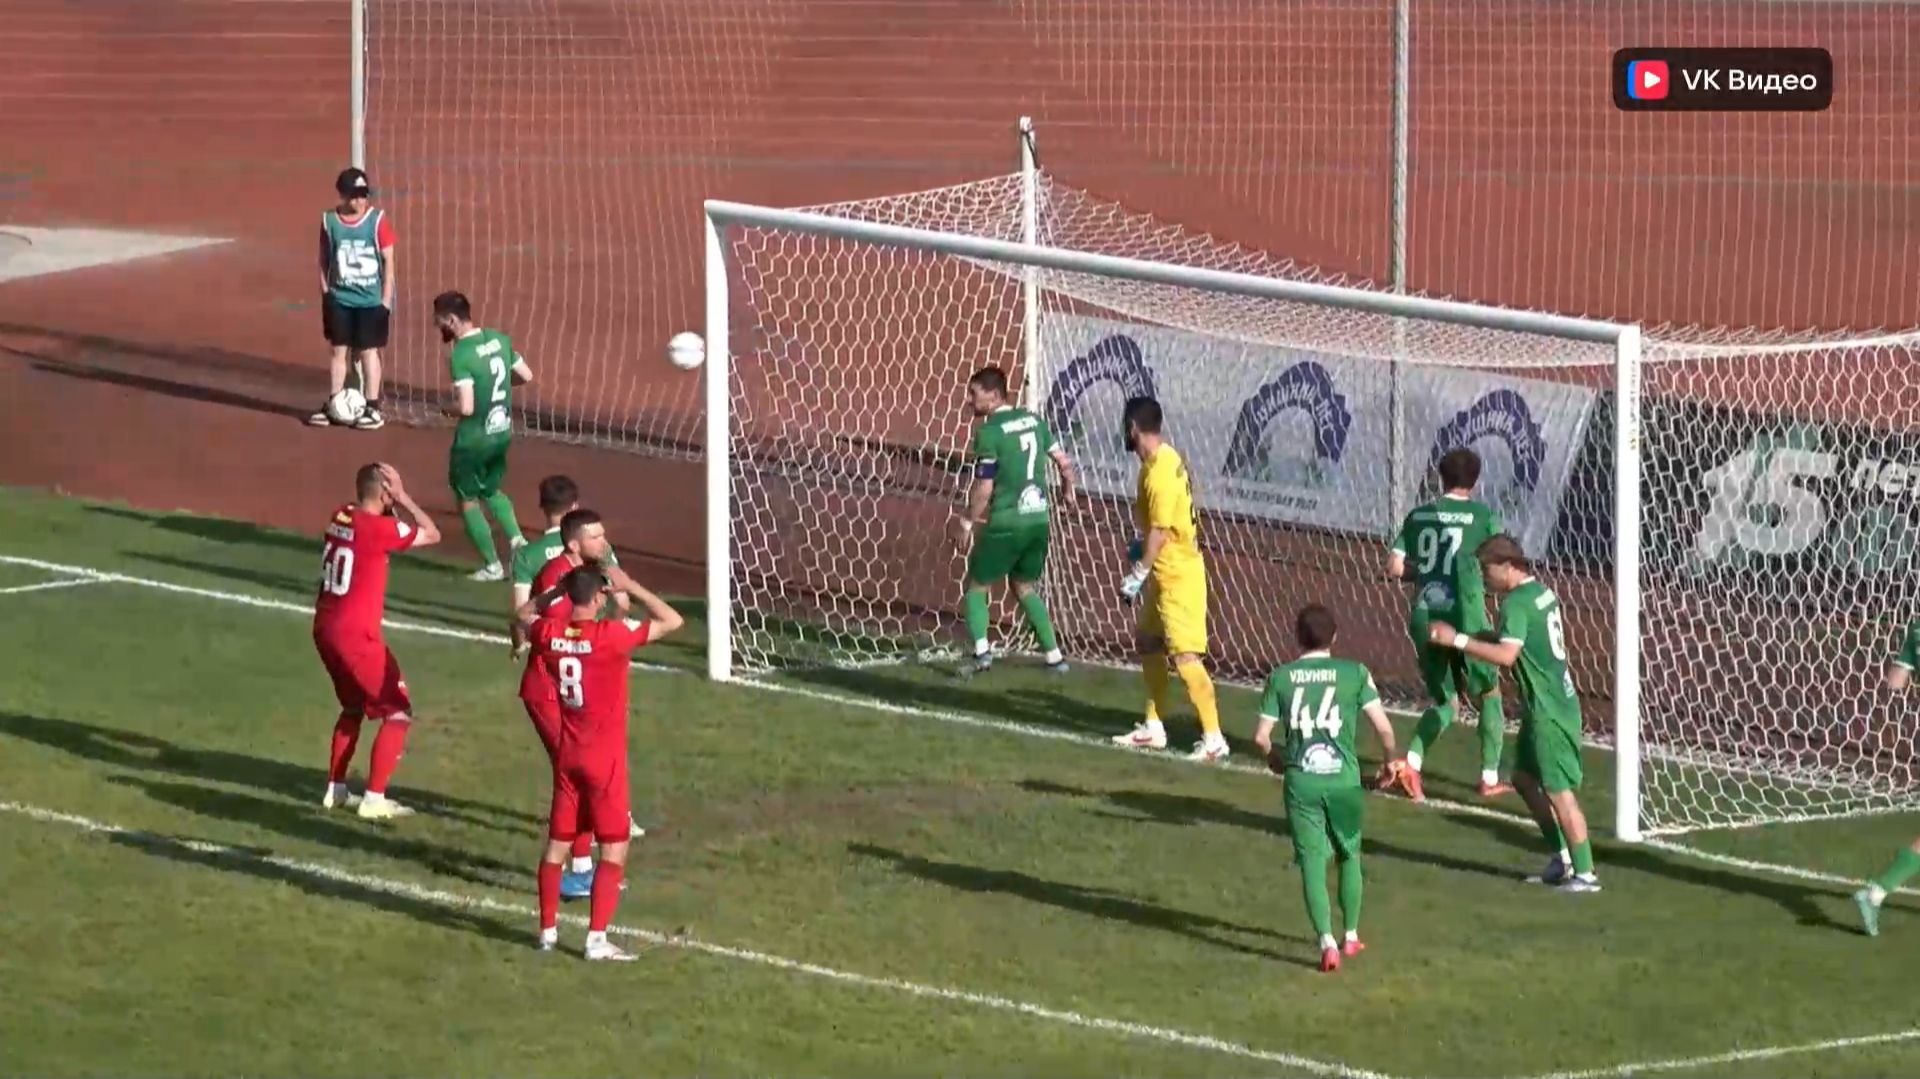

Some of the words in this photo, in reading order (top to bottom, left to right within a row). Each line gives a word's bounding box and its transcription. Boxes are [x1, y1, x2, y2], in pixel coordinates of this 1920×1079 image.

[489, 356, 507, 402] 2
[1019, 431, 1038, 480] 7
[1417, 527, 1464, 575] 97
[558, 656, 584, 709] 8
[1289, 686, 1343, 739] 44
